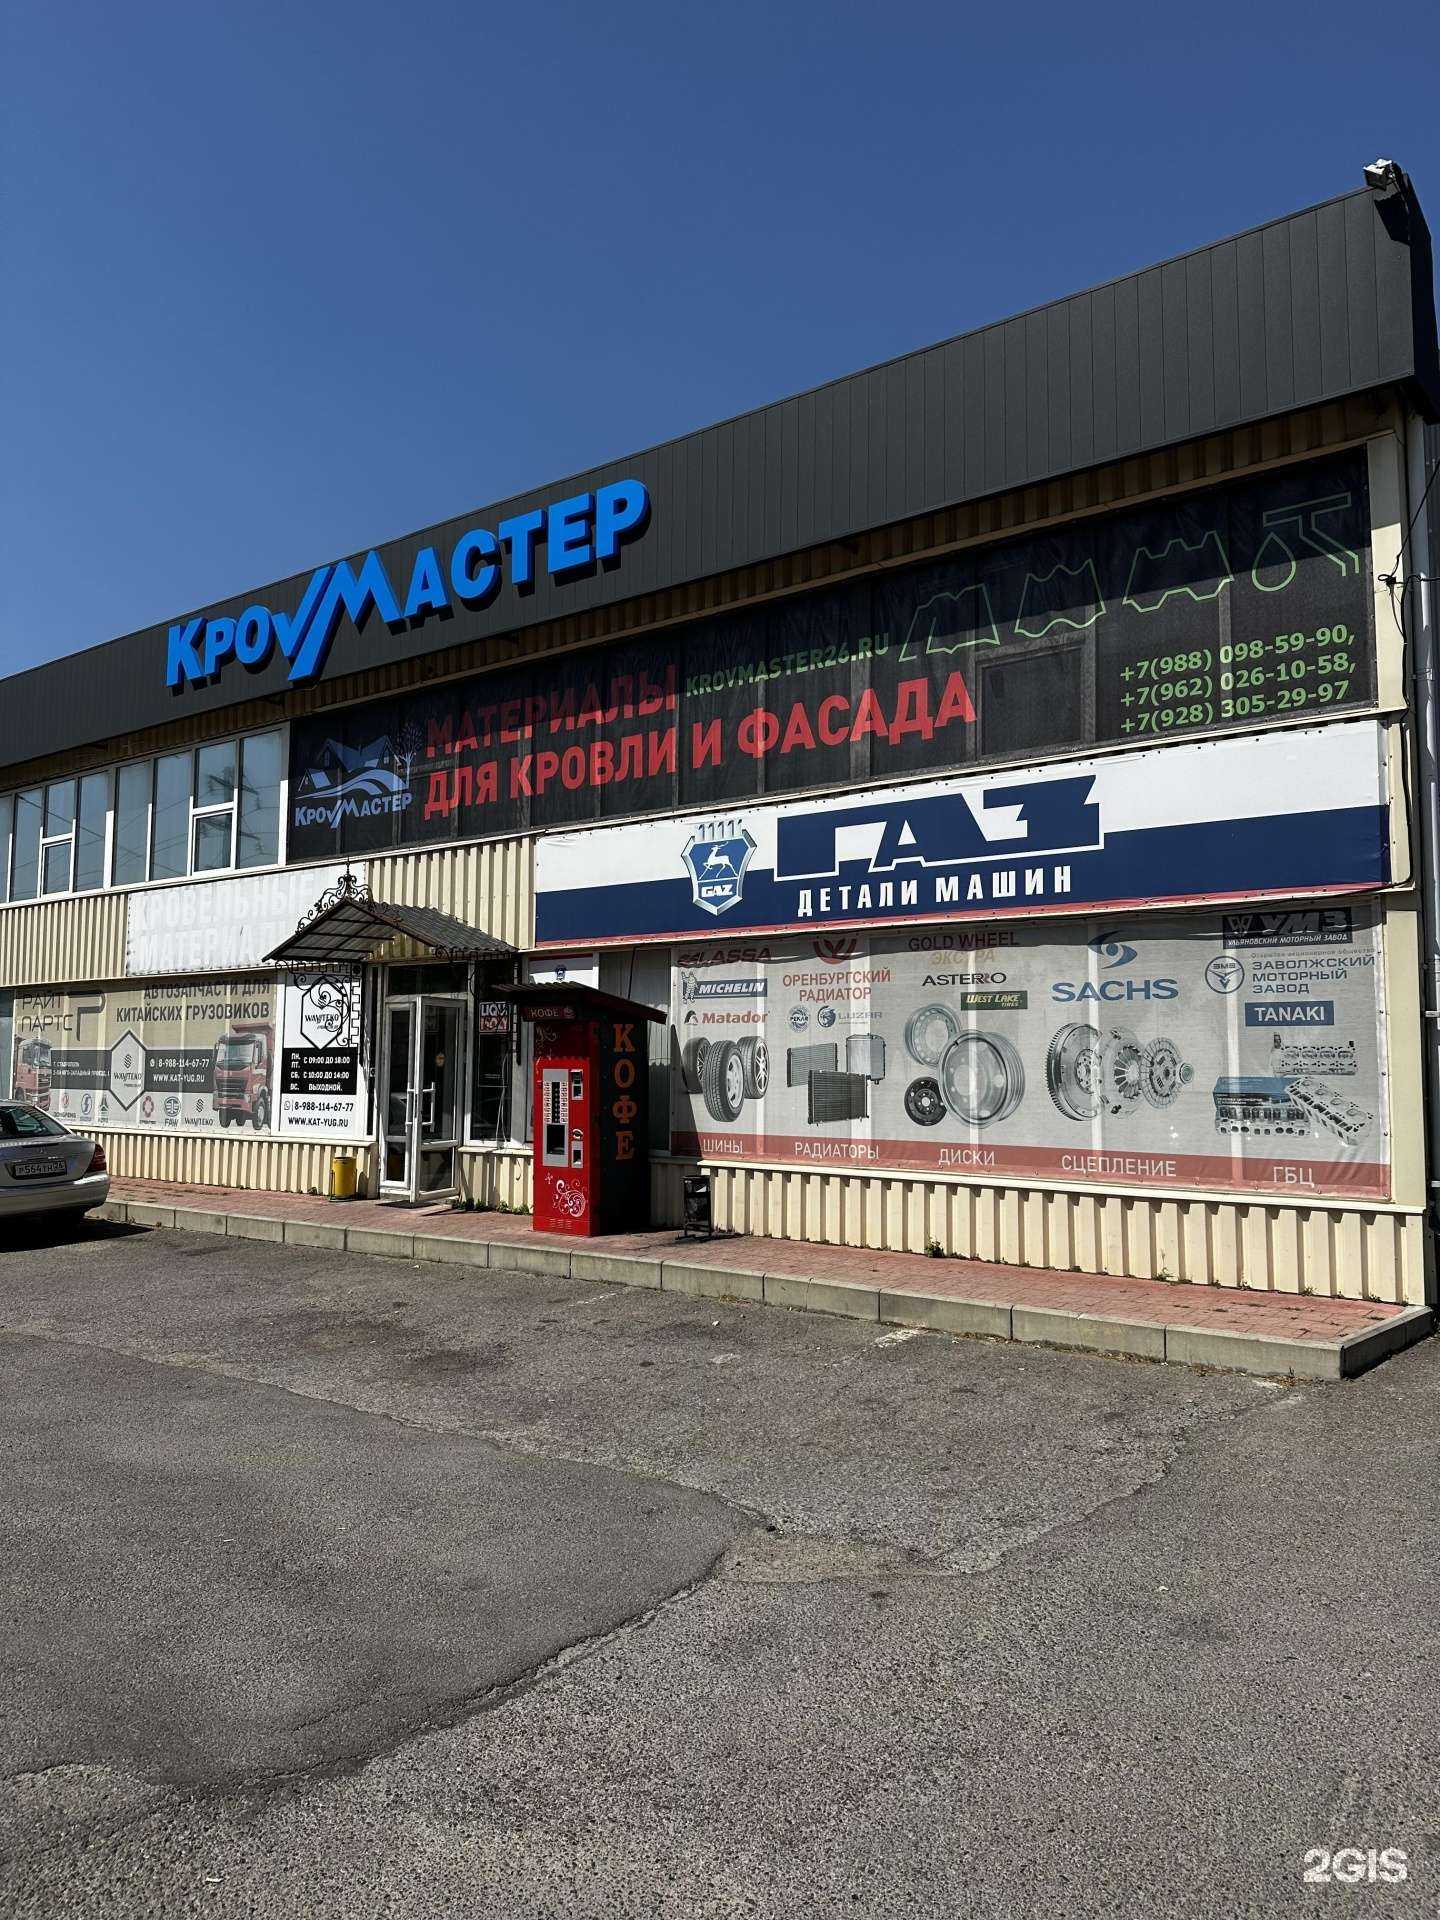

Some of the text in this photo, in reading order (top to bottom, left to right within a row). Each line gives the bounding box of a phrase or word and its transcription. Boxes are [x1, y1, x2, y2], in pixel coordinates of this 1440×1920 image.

[1120, 623, 1356, 684] +7(988) 098-59-90,
[685, 632, 889, 697] KROVMASTER26.RU
[1120, 652, 1357, 711] +7(962) 026-10-58,
[425, 664, 678, 758] МАТЕРИАЛЫ
[1120, 680, 1350, 734] +7(928) 305-29-97
[424, 671, 978, 821] ДЛЯ КРОВЛИ И ФАСАДА
[775, 774, 1100, 880] ГАЗ
[701, 885, 734, 898] GAZ
[797, 866, 1072, 918] ДЕТАЛИ МАШИН
[908, 931, 1020, 952] GOLD WHEEL
[1279, 934, 1322, 944] МОТОРНЫЙ
[1323, 932, 1348, 942] ЗАВОД
[1252, 954, 1375, 970] ЗАВОЛЖСКИЙ
[783, 967, 891, 987] ОРЕНБУРГСКИЙ
[1252, 968, 1347, 982] МОТОРНЫЙ
[143, 978, 270, 1000] АВТОЗАПЧАСТИ ДЛЯ
[698, 981, 766, 995] MICHELIN
[799, 986, 872, 1003] РАДИАТОР
[1051, 978, 1179, 1002] SACHS
[1252, 984, 1310, 995] ЗАВОД
[116, 1002, 270, 1023] КИТАЙСКИХ ГРУЗОВИКОВ
[701, 1010, 768, 1024] Matador
[1254, 1006, 1325, 1021] TANAKI
[21, 1014, 74, 1032] ПАРТС
[158, 1058, 210, 1069] 8-988-114-67-77
[153, 1073, 205, 1083] WWW.KAT-YUG.RU
[613, 1023, 637, 1161] КОФЕ
[294, 1101, 354, 1112] 8-988-114-67-77
[287, 1116, 349, 1128] WWW.KAT-YUG.RU
[703, 1138, 743, 1154] ШИНЫ
[794, 1141, 880, 1160] РАДИАТОРЫ
[938, 1148, 996, 1167] ДИСКИ
[1061, 1154, 1177, 1178] СЦЕПЛЕНИЕ
[1273, 1165, 1315, 1188] ГБЦ
